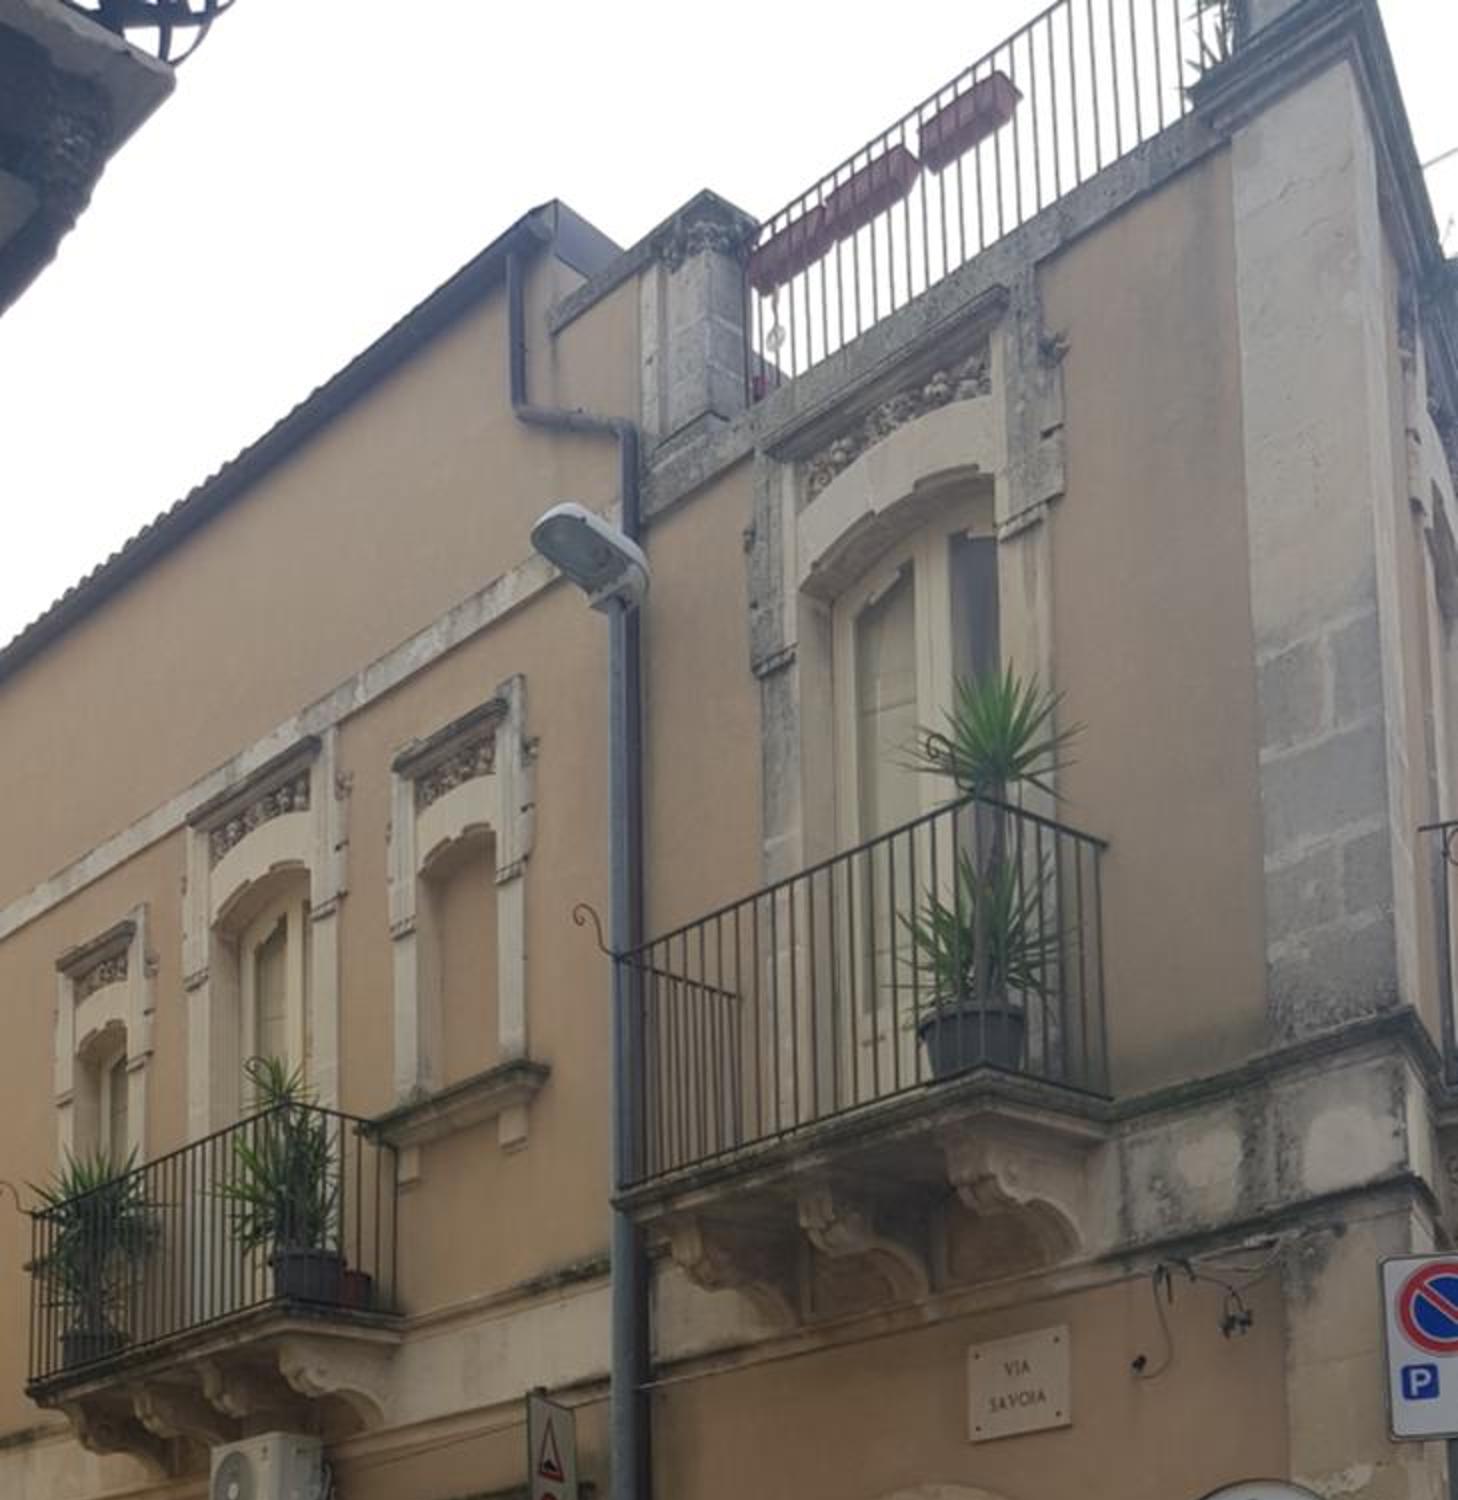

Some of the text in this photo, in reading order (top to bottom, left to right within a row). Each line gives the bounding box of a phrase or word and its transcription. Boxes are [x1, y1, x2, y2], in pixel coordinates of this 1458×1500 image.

[1004, 1359, 1031, 1377] VIA
[1409, 1367, 1432, 1397] P
[989, 1389, 1047, 1413] SAVOIA
